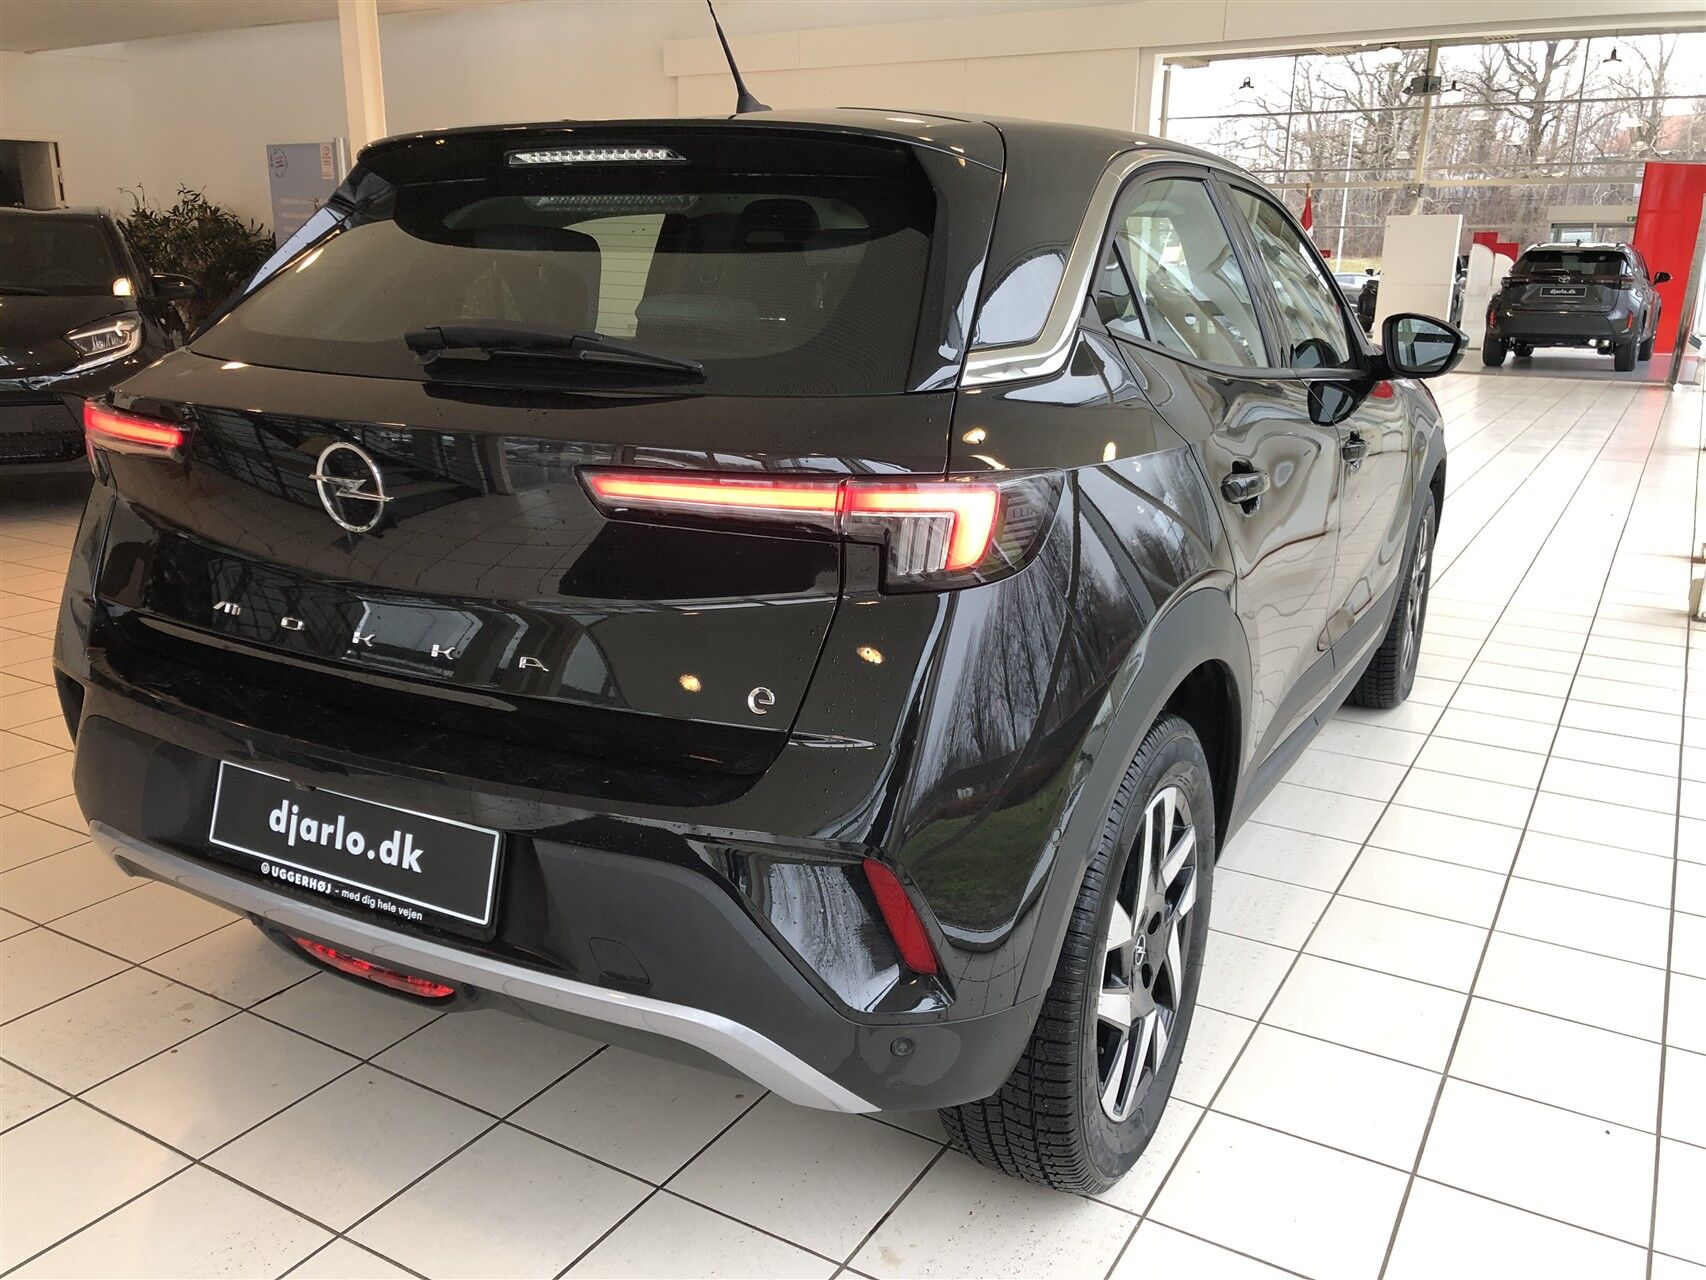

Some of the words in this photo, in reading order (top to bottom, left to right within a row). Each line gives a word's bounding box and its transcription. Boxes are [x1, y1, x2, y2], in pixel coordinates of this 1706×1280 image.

[747, 686, 776, 715] e
[269, 800, 424, 873] djarlo.dk
[271, 866, 332, 894] UGGERHØJ
[341, 889, 361, 902] med
[361, 895, 376, 909] dig
[377, 899, 397, 913] hele
[398, 906, 423, 921] vejen
